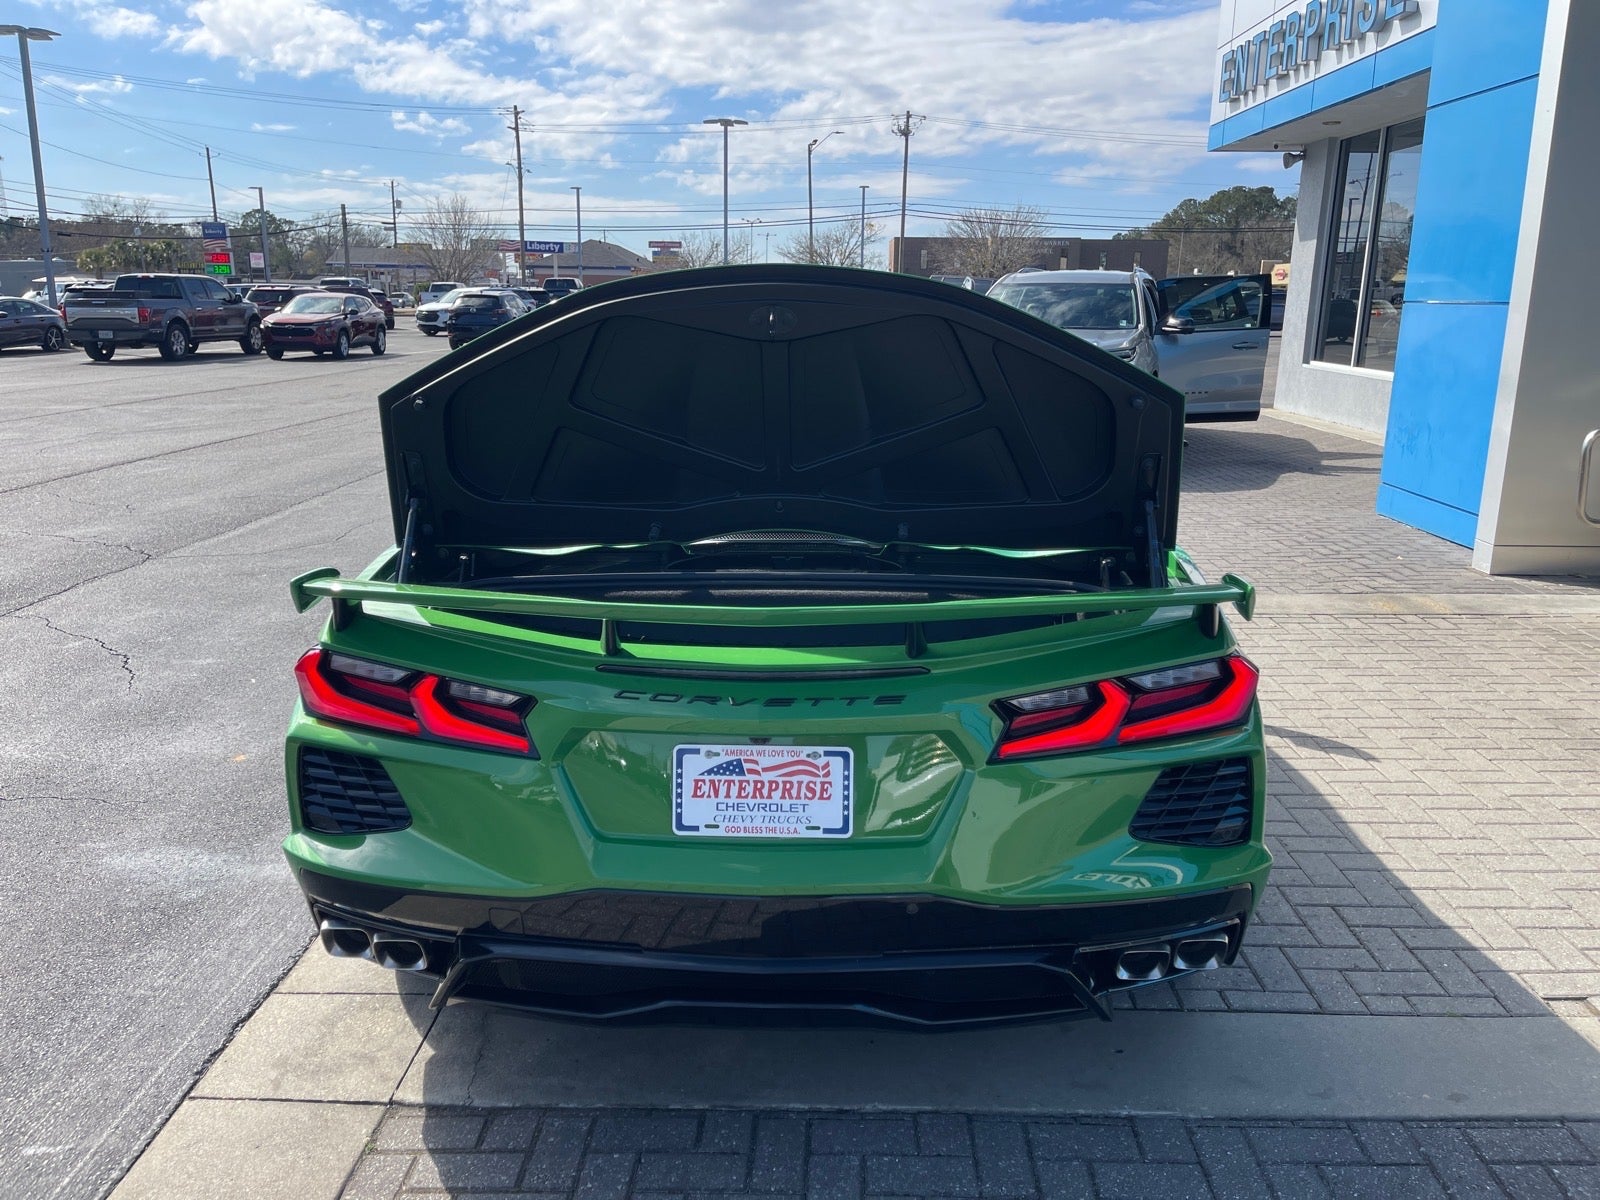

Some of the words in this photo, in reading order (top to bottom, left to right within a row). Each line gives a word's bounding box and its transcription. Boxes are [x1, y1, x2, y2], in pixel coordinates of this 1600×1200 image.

[526, 241, 560, 252] Liberty
[613, 690, 907, 707] CORVETTE
[756, 750, 767, 758] WE
[767, 750, 784, 758] LOVE
[691, 778, 833, 801] ENTERPRISE
[716, 801, 809, 813] CHEVROLET
[713, 814, 757, 824] CHEVY
[760, 814, 812, 825] TRUCKS
[724, 825, 742, 834] GOD
[743, 826, 763, 834] BLESS
[764, 826, 778, 834] THE
[779, 826, 801, 835] U.S.A.
